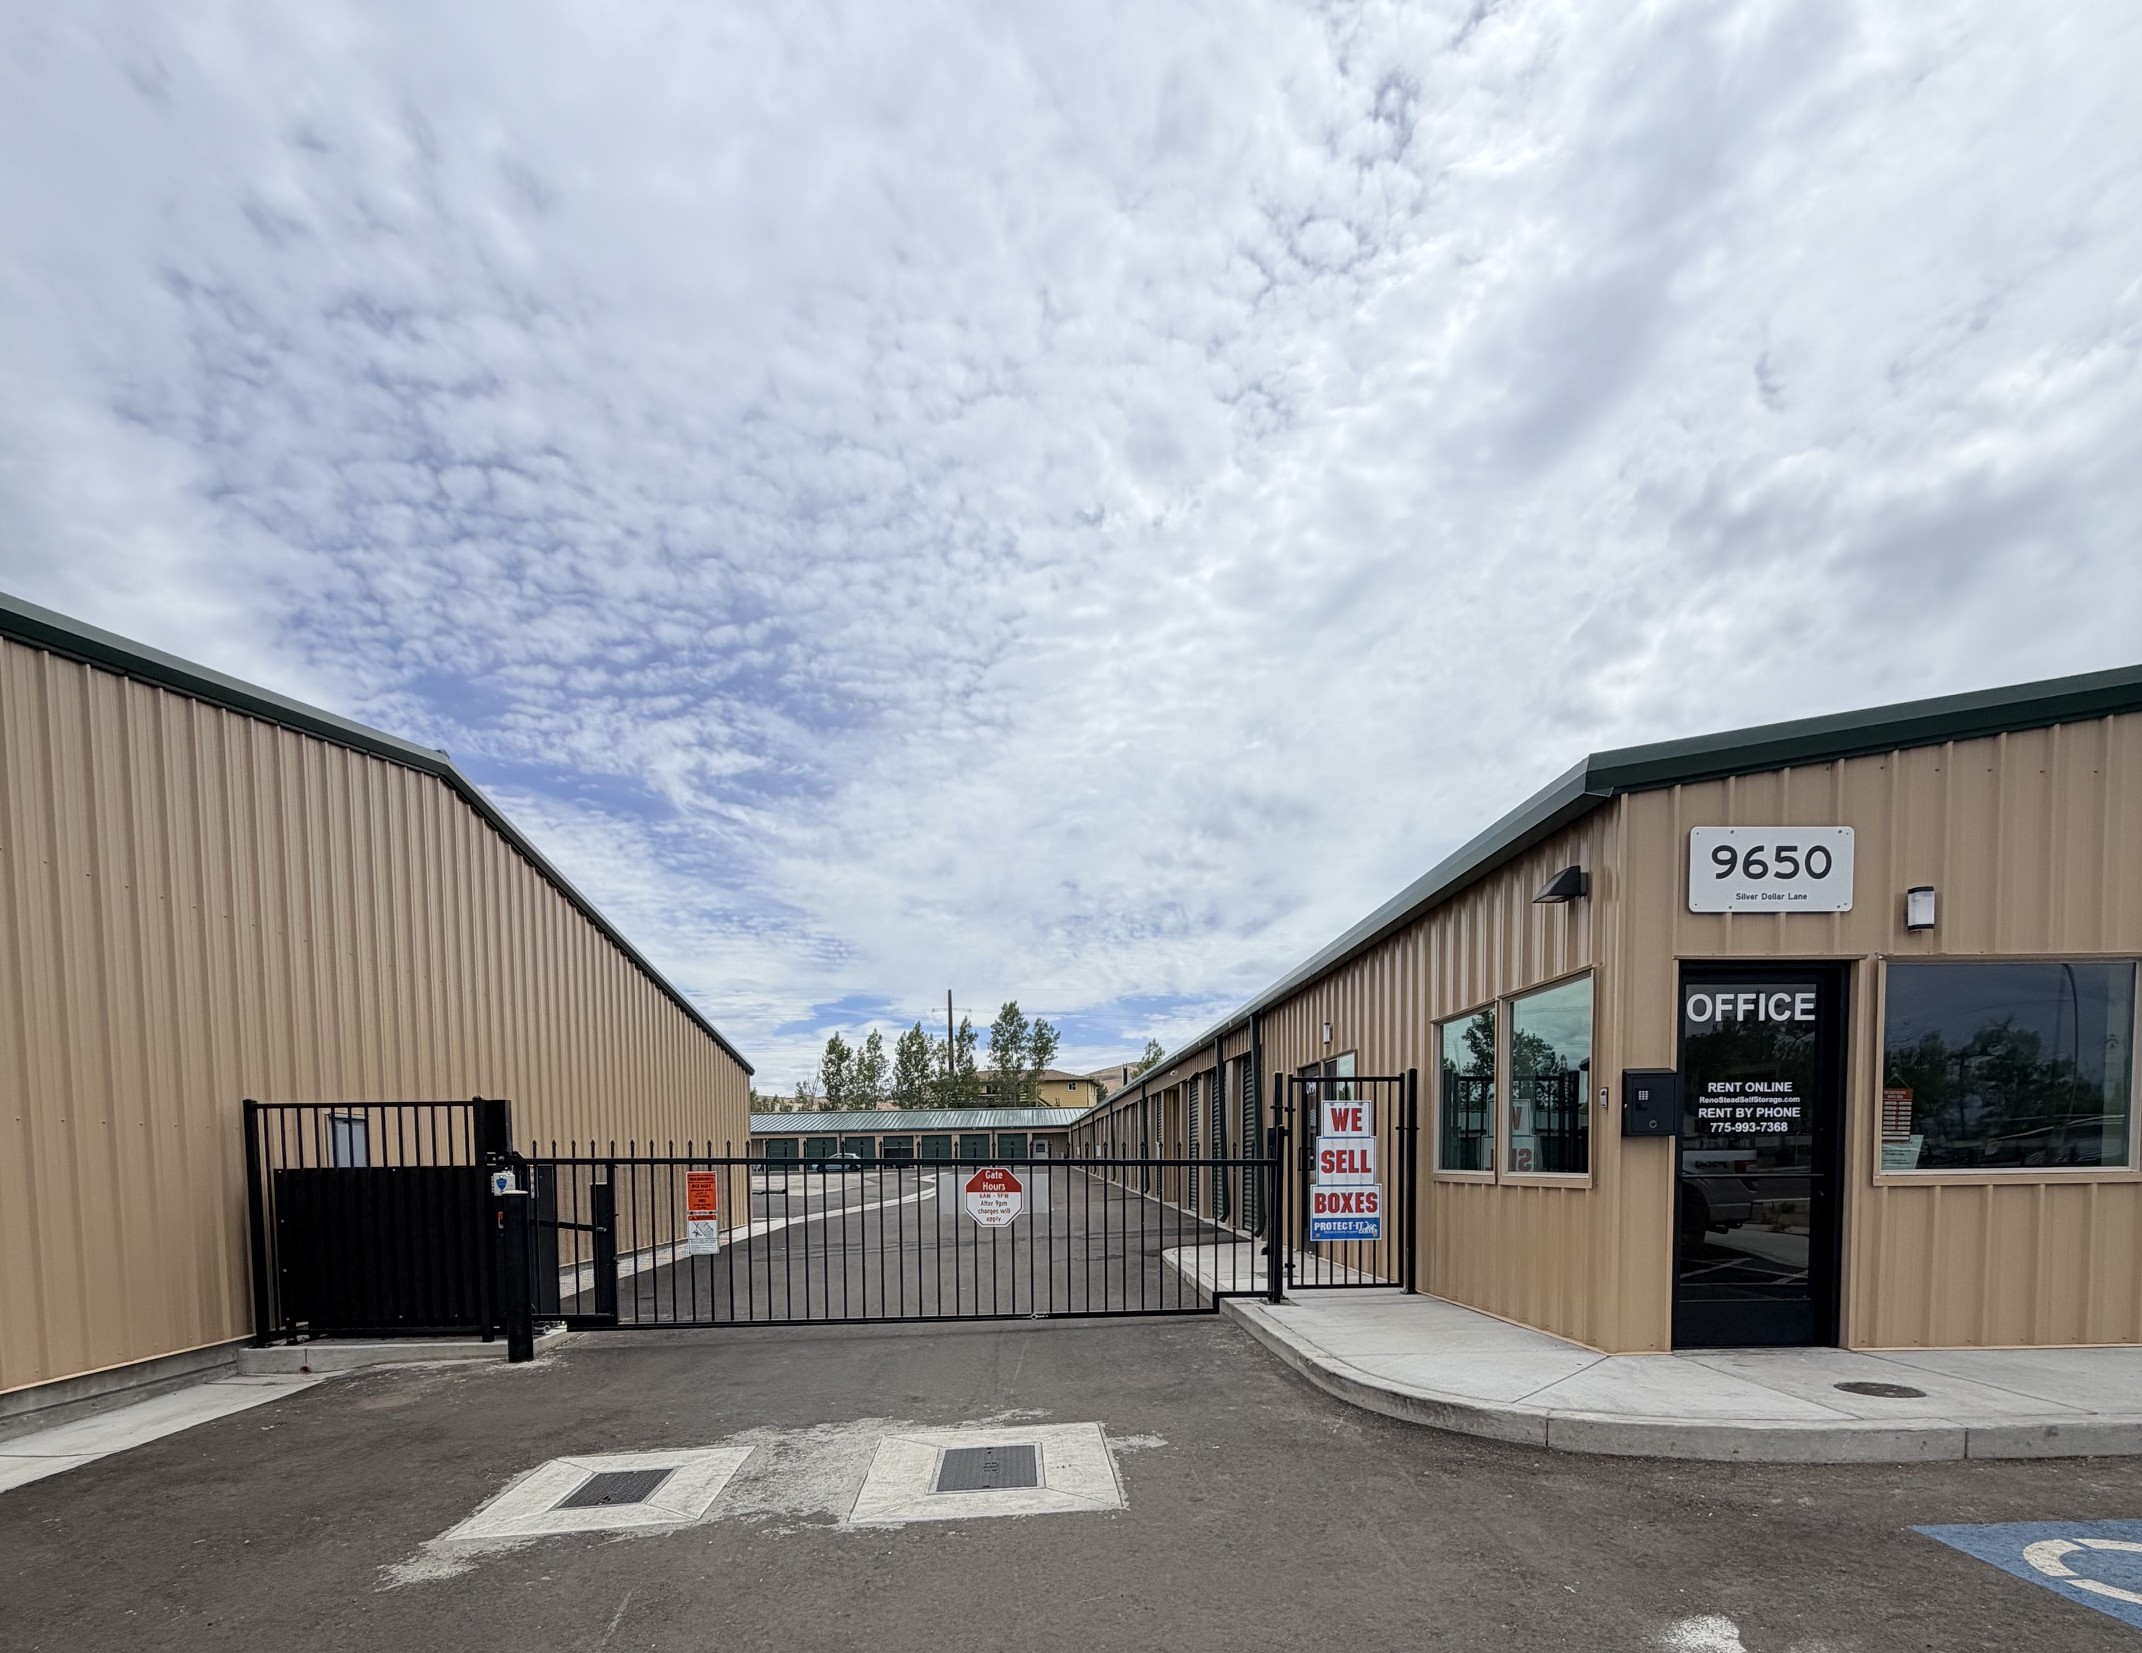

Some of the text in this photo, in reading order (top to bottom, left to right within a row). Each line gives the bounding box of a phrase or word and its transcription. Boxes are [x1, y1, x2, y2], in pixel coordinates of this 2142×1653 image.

[1711, 844, 1833, 880] 9650
[1735, 892, 1808, 900] Silver Dollar Lane
[1686, 992, 1816, 1022] OFFICE
[1707, 1081, 1793, 1093] RENT ONLINE
[1699, 1096, 1801, 1104] RenoSteadSelfStorage.com
[1698, 1106, 1801, 1118] RENT BY PHONE
[1330, 1107, 1363, 1132] WE
[1710, 1121, 1788, 1133] 775-993-7368
[1321, 1149, 1372, 1174] SELL
[985, 1170, 1003, 1179] Gate
[982, 1181, 1006, 1191] Hours
[1314, 1191, 1378, 1214] BOXES
[1314, 1221, 1364, 1231] PROTECT-IT
